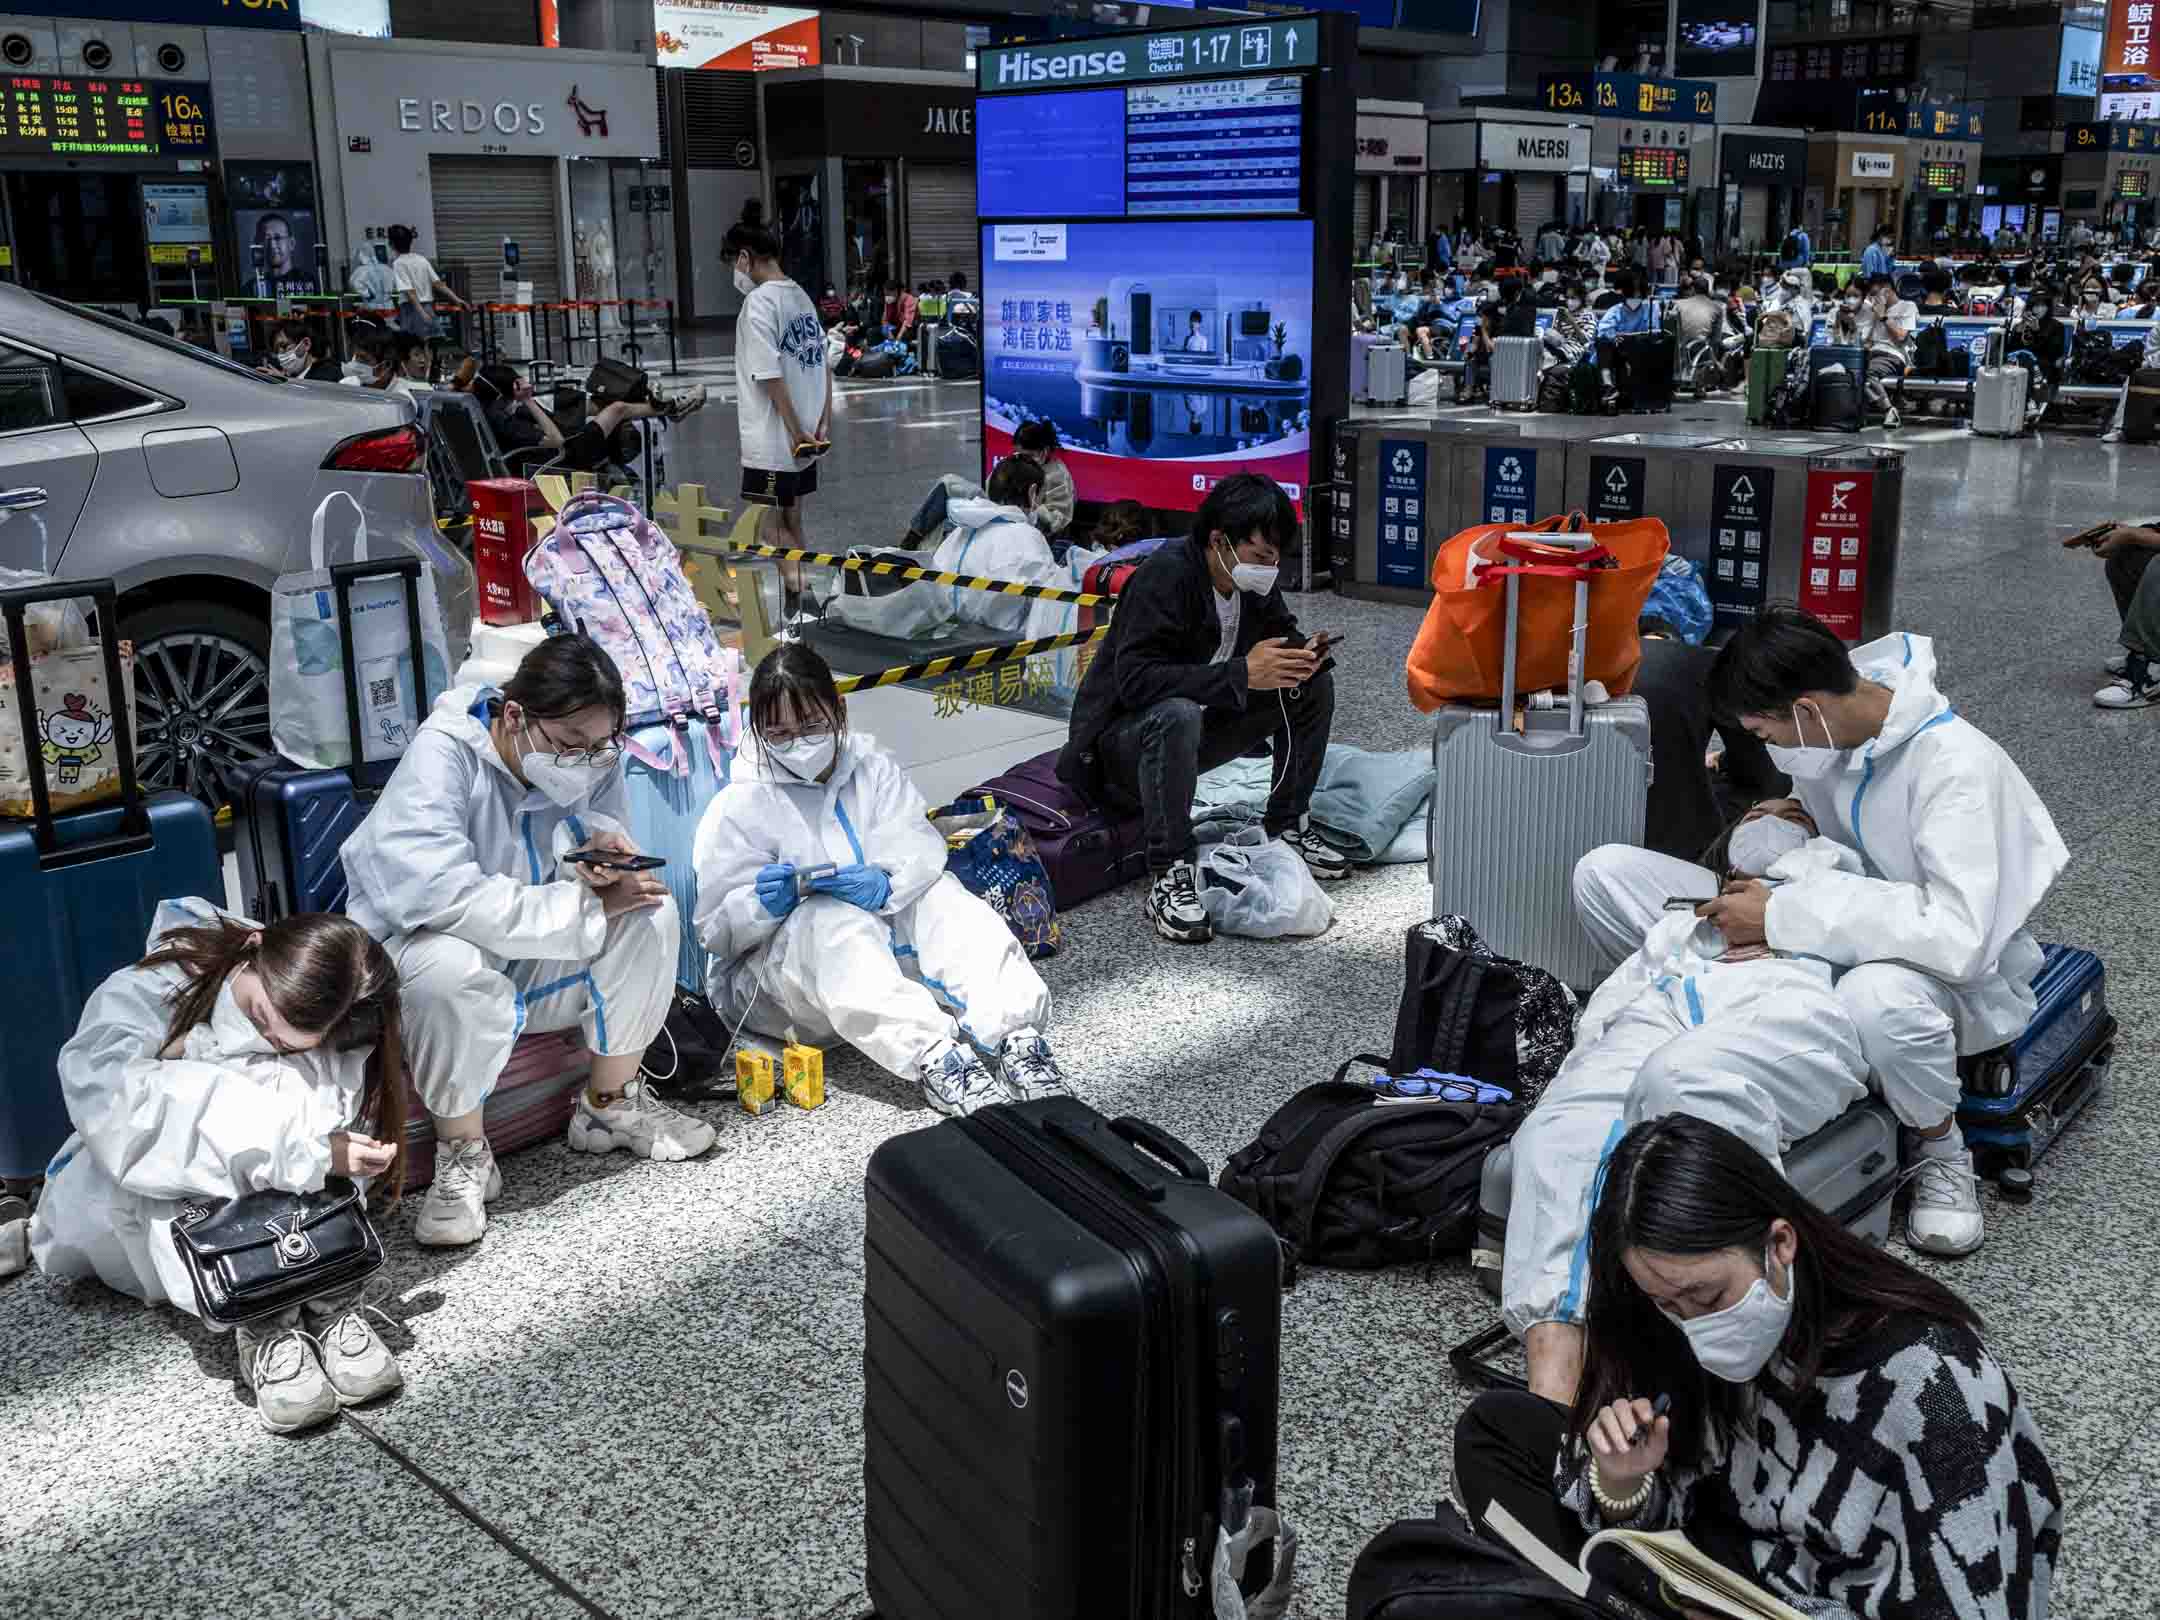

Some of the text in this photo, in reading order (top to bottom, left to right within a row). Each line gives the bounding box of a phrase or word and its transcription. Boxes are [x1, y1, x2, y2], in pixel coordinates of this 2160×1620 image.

[1192, 34, 1232, 65] 1-17
[998, 50, 1126, 84] Hisense
[1149, 61, 1184, 73] Check in
[1546, 82, 1583, 107] 13A
[161, 95, 204, 120] 16A
[398, 98, 546, 135] ERDOS
[922, 105, 973, 135] JAKE
[165, 121, 206, 138] 检票口
[1866, 111, 1898, 131] 11A
[1516, 138, 1569, 160] NAERSI
[1748, 153, 1785, 171] HAZZYS
[1001, 299, 1073, 323] 旗舰家电
[1001, 327, 1073, 352] 海信优选
